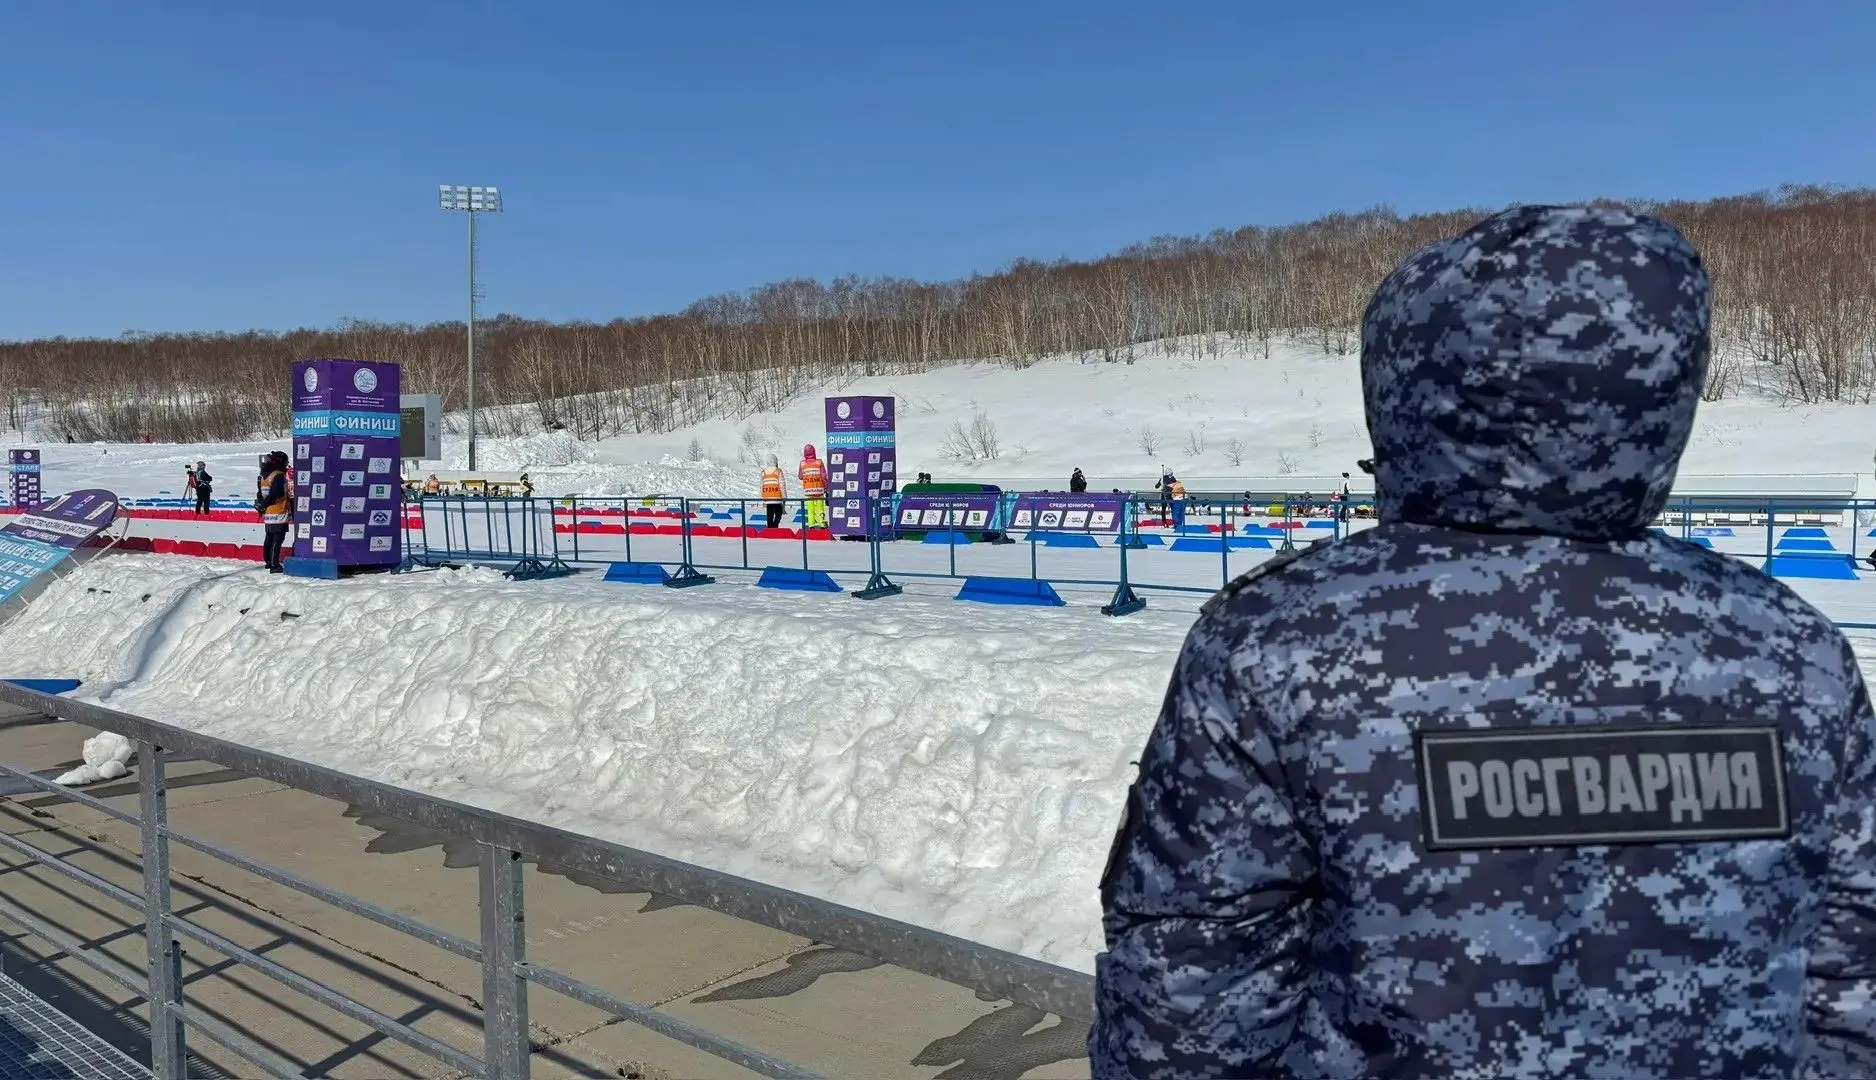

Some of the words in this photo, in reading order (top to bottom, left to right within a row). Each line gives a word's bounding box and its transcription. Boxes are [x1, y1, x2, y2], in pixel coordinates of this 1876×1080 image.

[293, 416, 328, 430] ФИНИШ
[335, 416, 396, 431] ФИНИШ
[828, 435, 861, 444] ФИНИШ
[865, 434, 895, 443] ФИНИШ
[1447, 751, 1763, 823] РОСГВАРДИЯ
